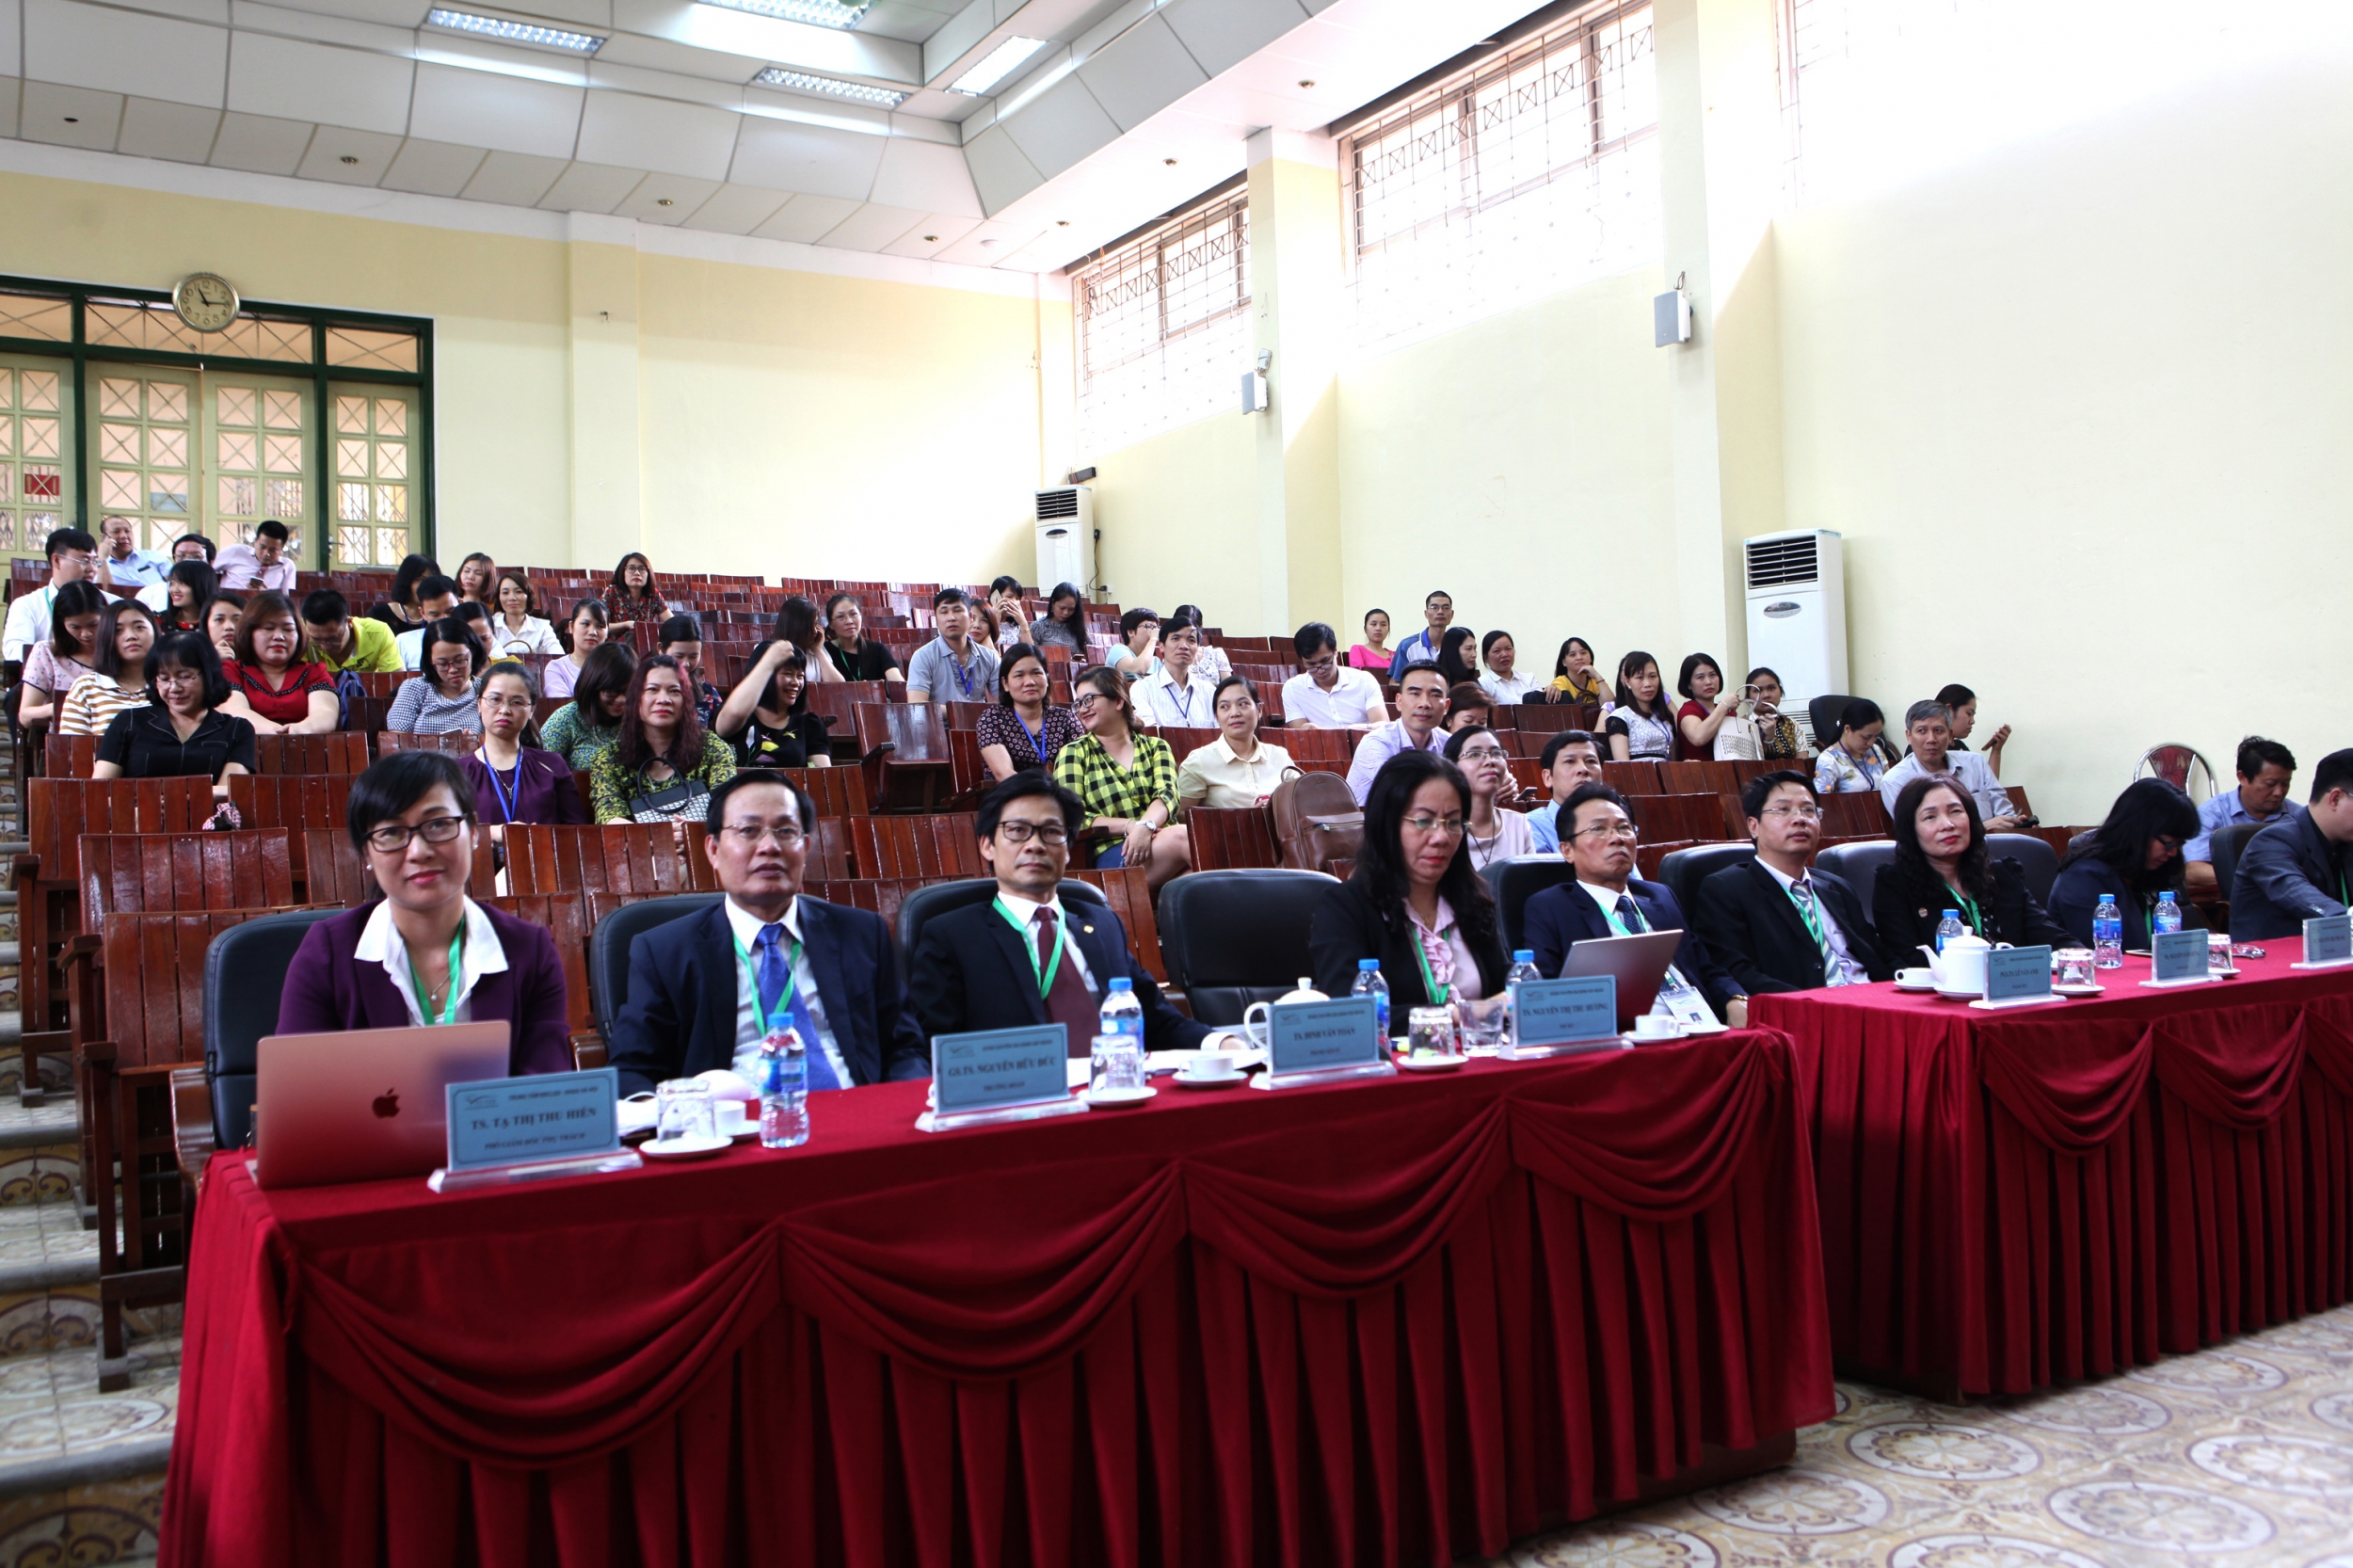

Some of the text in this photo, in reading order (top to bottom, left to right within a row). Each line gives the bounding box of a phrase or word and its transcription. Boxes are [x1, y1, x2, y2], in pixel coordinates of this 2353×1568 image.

[471, 1120, 489, 1130] TS.
[492, 1117, 509, 1129] TẠ
[512, 1114, 535, 1127] THỊ
[536, 1112, 563, 1123] THU
